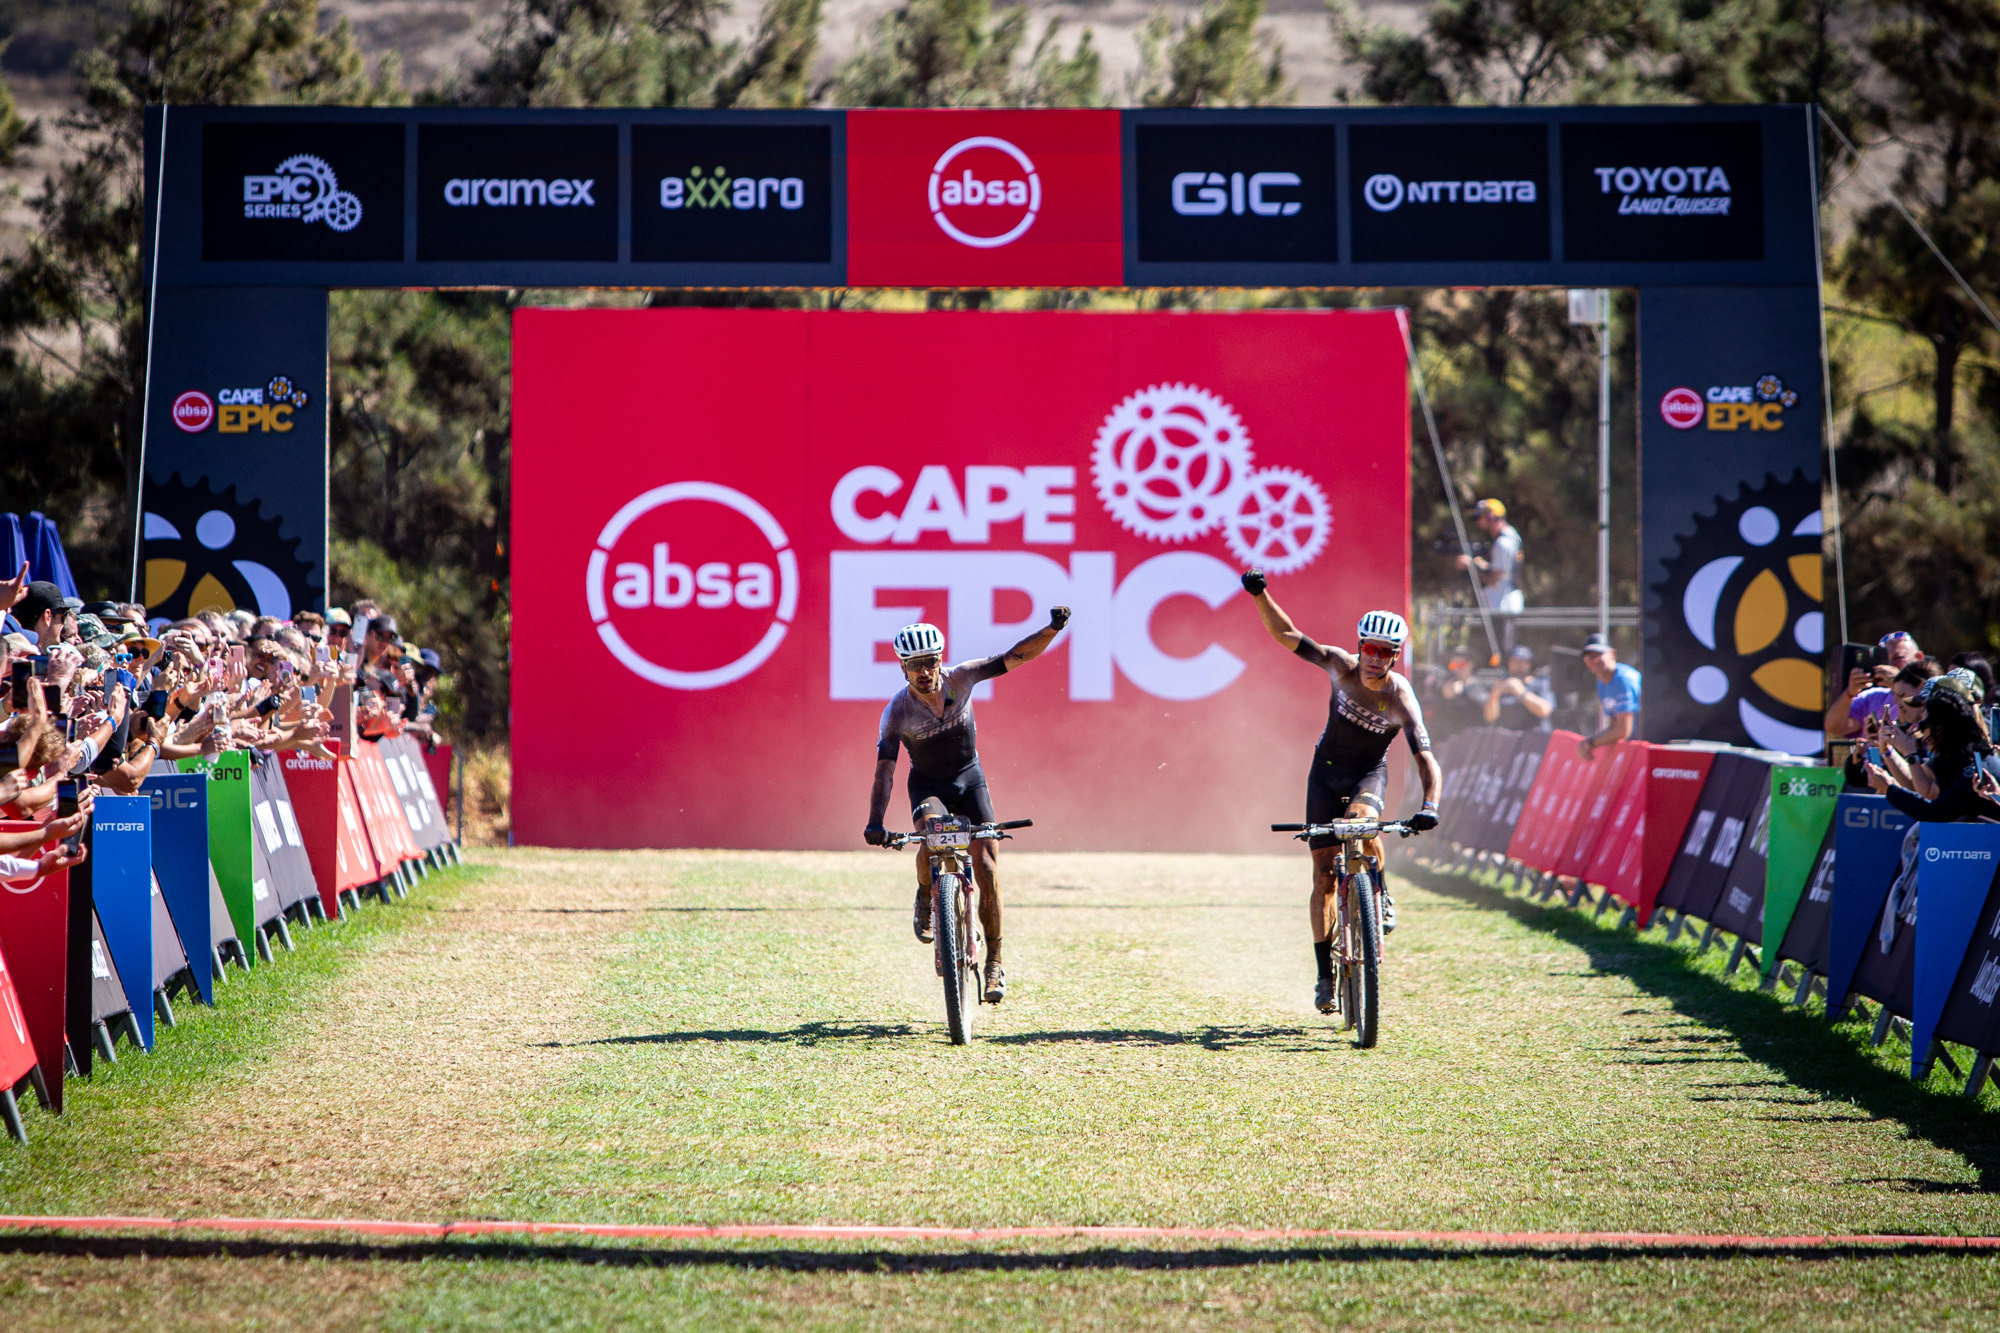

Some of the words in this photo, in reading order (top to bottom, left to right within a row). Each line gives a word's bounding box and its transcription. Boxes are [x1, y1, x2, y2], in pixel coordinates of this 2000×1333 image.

[244, 175, 313, 203] EPIC
[444, 178, 595, 206] aramex
[660, 166, 804, 209] exxaro
[942, 168, 1028, 206] absa
[1407, 181, 1462, 203] NTT
[1594, 166, 1731, 193] TOYOTA
[1171, 171, 1302, 216] GIC
[244, 203, 302, 218] SERIES
[218, 388, 264, 405] CAPE
[1706, 386, 1754, 403] CAPE
[178, 402, 208, 417] absa
[217, 403, 294, 433] EPIC
[1706, 402, 1784, 431] EPIC
[830, 465, 1076, 544] CAPE
[611, 542, 774, 609] absa
[829, 550, 1247, 701] EPIC
[285, 757, 334, 770] aramex
[1779, 777, 1837, 797] exxaro
[95, 823, 116, 832] NTT
[1844, 806, 1905, 831] GIC
[940, 835, 957, 844] 2-1
[1941, 850, 1963, 859] NTT
